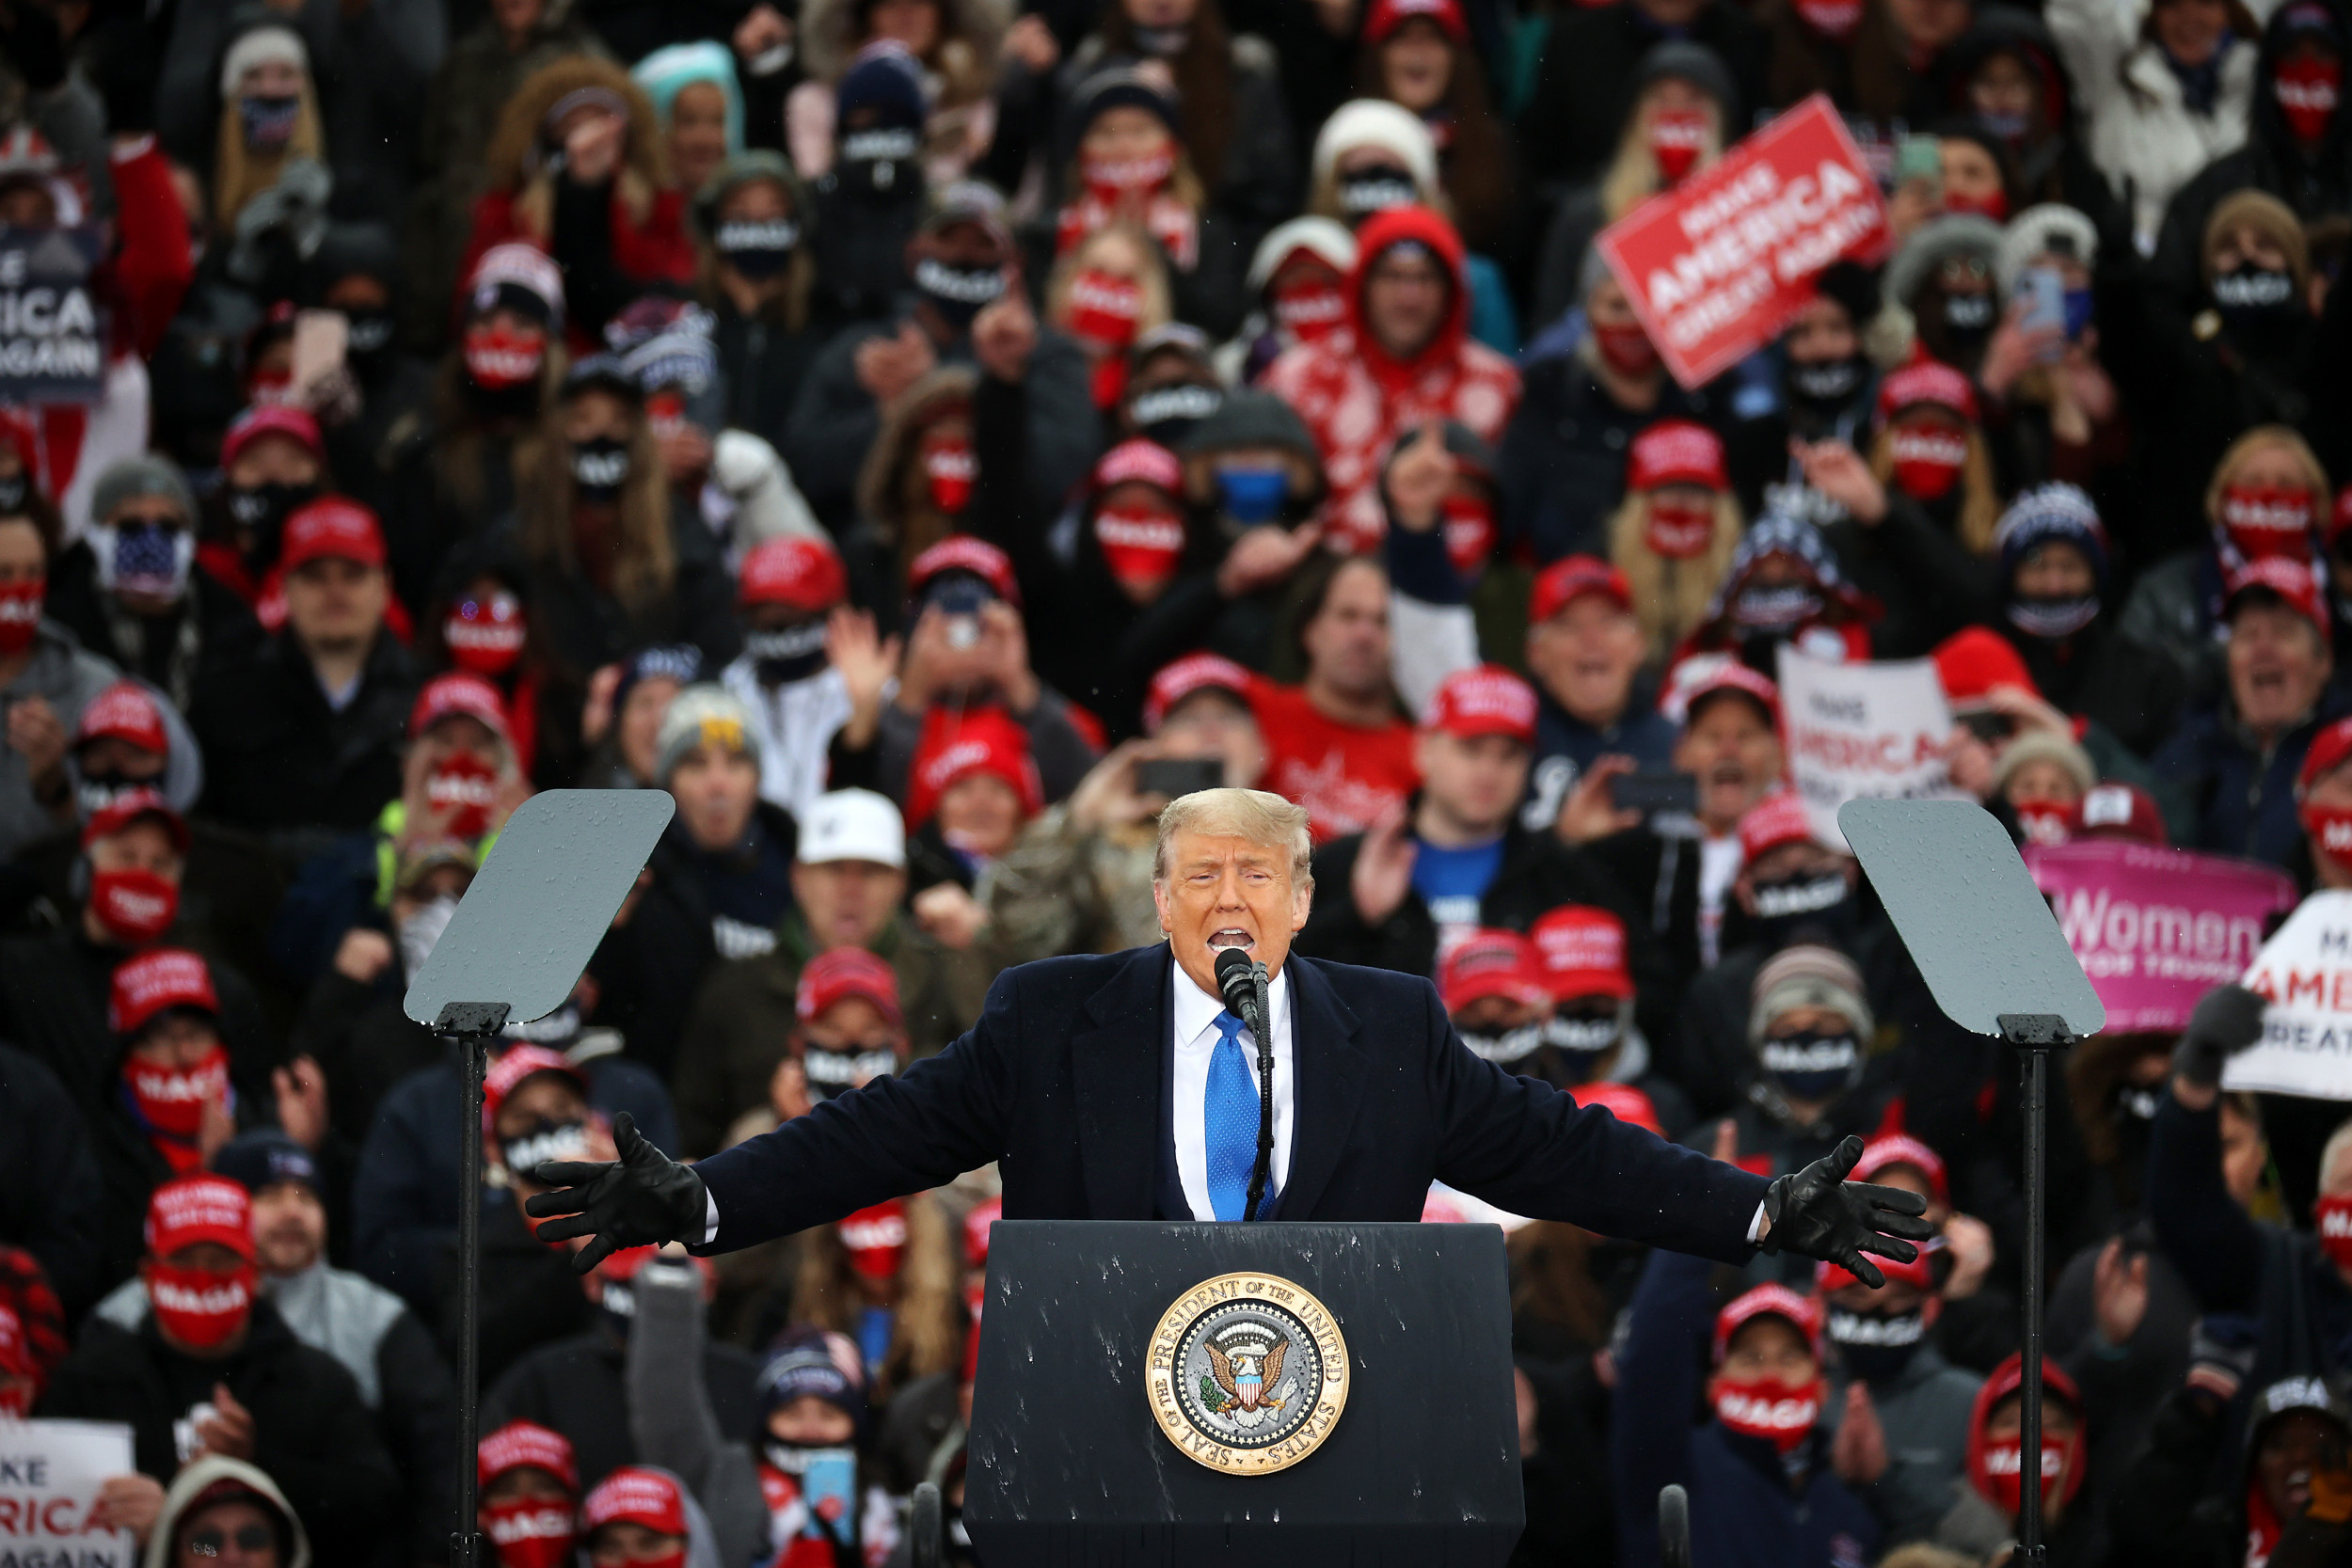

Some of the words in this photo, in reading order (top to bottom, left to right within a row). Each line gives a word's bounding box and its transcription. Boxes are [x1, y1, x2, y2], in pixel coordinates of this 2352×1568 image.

[1649, 160, 1860, 312] AMERICA
[2054, 887, 2262, 959] Women
[1245, 1281, 1264, 1294] OF
[1268, 1285, 1295, 1306] THE
[1153, 1279, 1240, 1371] PRESIDENT
[1298, 1300, 1344, 1384] UNITED
[1155, 1378, 1172, 1406] THE
[1716, 1392, 1818, 1430] MAGA
[1164, 1409, 1182, 1428] OF
[1267, 1402, 1336, 1465] STATES
[1180, 1422, 1233, 1466] SEAL
